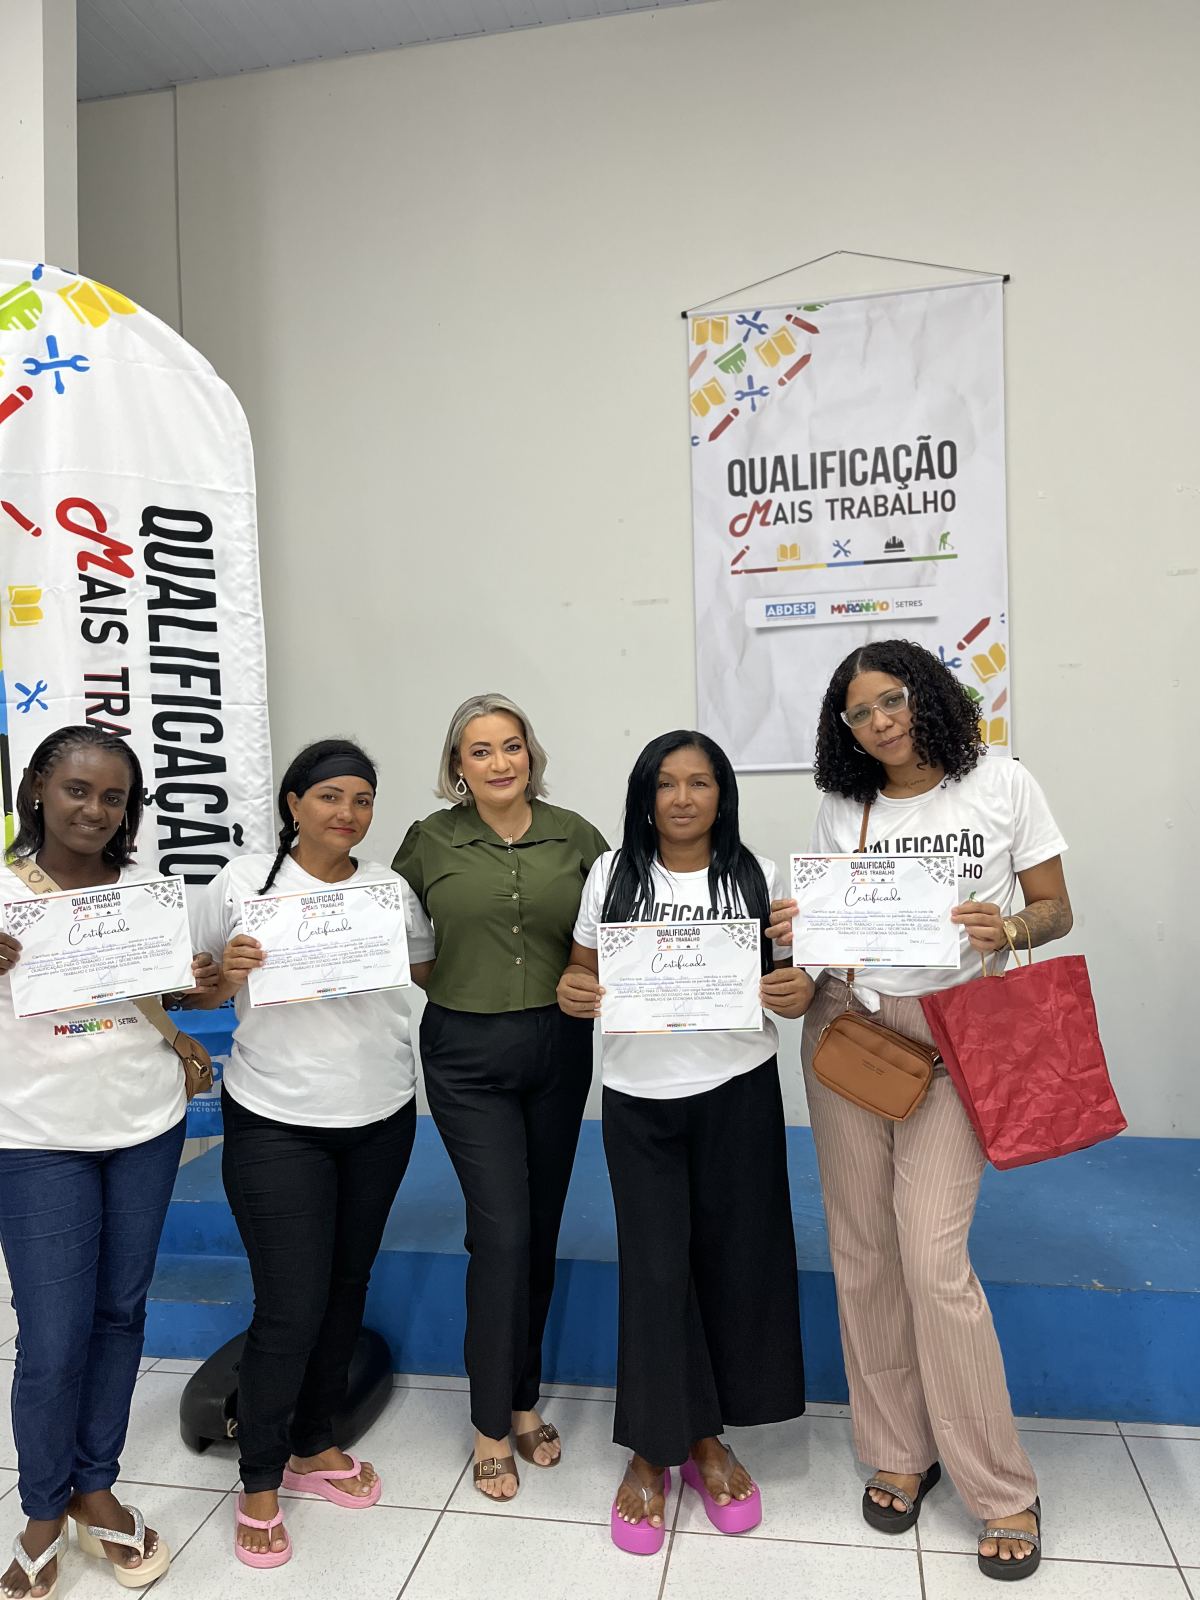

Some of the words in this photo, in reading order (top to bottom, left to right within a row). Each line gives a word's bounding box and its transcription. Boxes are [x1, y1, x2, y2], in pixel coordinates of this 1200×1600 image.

[727, 434, 958, 498] QUALIFICAÇÃO
[728, 498, 813, 538] MAIS
[825, 489, 957, 521] TRABALHO
[56, 497, 135, 644] MAIS
[766, 602, 815, 617] ABDESP
[895, 599, 923, 608] SETRES
[138, 504, 244, 885] QUALIFICAÇÃO
[850, 859, 896, 870] QUALIFICAÇÃO
[71, 891, 121, 907] QUALIFICAÇÃO
[300, 892, 344, 906] QUALIFICAÇÃO
[844, 885, 901, 907] Certificado
[94, 900, 121, 910] TRABALHO
[320, 901, 345, 909] TRABALHO
[68, 918, 130, 946] Certificado
[297, 917, 353, 943] Certificado
[656, 927, 701, 938] QUALIFICAÇÃO
[651, 952, 706, 974] Certificado
[117, 1016, 138, 1026] SETRES
